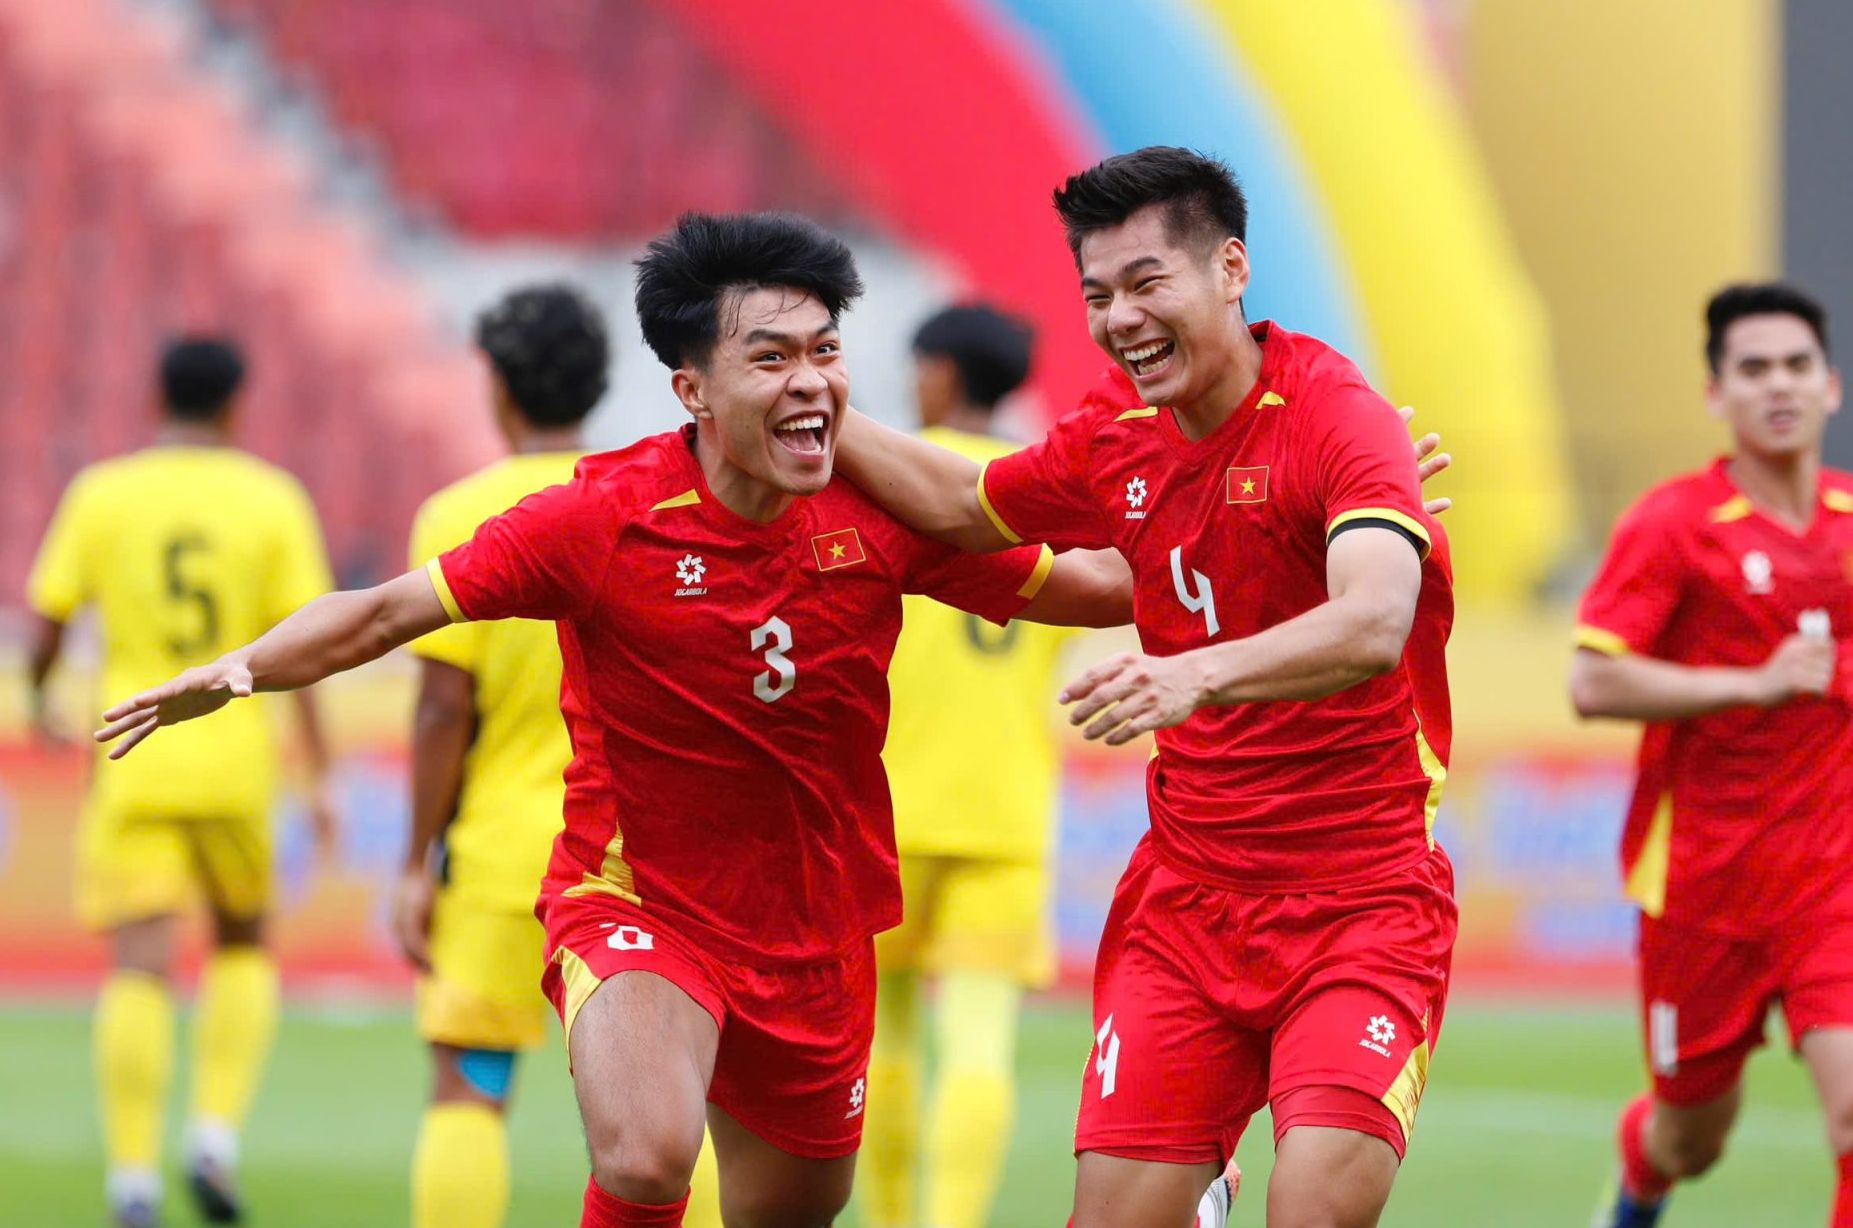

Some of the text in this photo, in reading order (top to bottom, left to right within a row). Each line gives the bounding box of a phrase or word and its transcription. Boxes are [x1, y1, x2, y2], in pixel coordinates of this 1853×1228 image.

[163, 526, 219, 657] 5
[1169, 544, 1221, 638] 4
[750, 615, 796, 704] 3
[1095, 1012, 1120, 1100] 4
